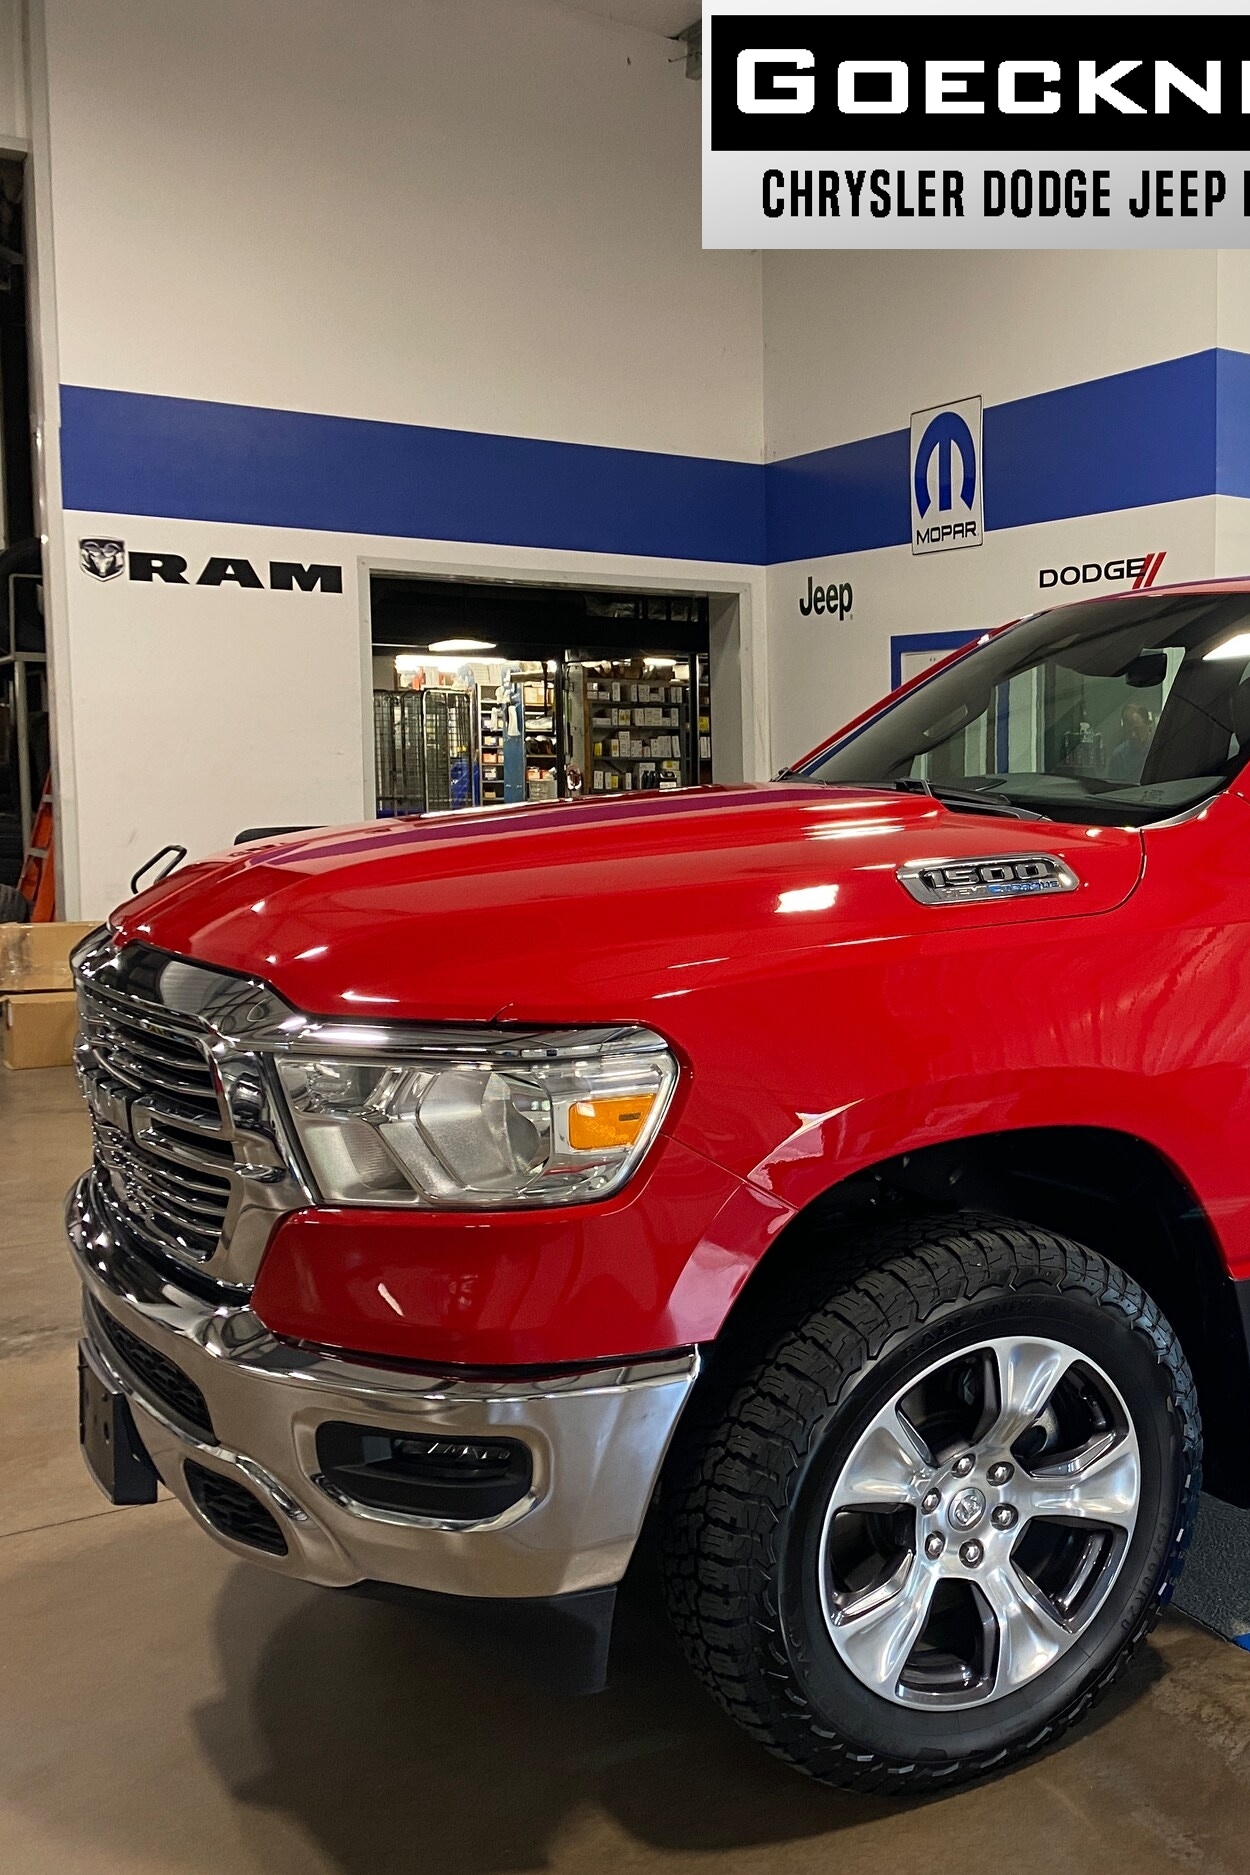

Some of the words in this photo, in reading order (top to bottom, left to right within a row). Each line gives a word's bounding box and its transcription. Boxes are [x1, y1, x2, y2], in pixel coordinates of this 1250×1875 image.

[916, 520, 978, 546] MOPAR
[128, 551, 343, 594] RAM
[1039, 557, 1147, 588] DODGE
[799, 576, 853, 621] Jeep
[924, 862, 1050, 888] 1500
